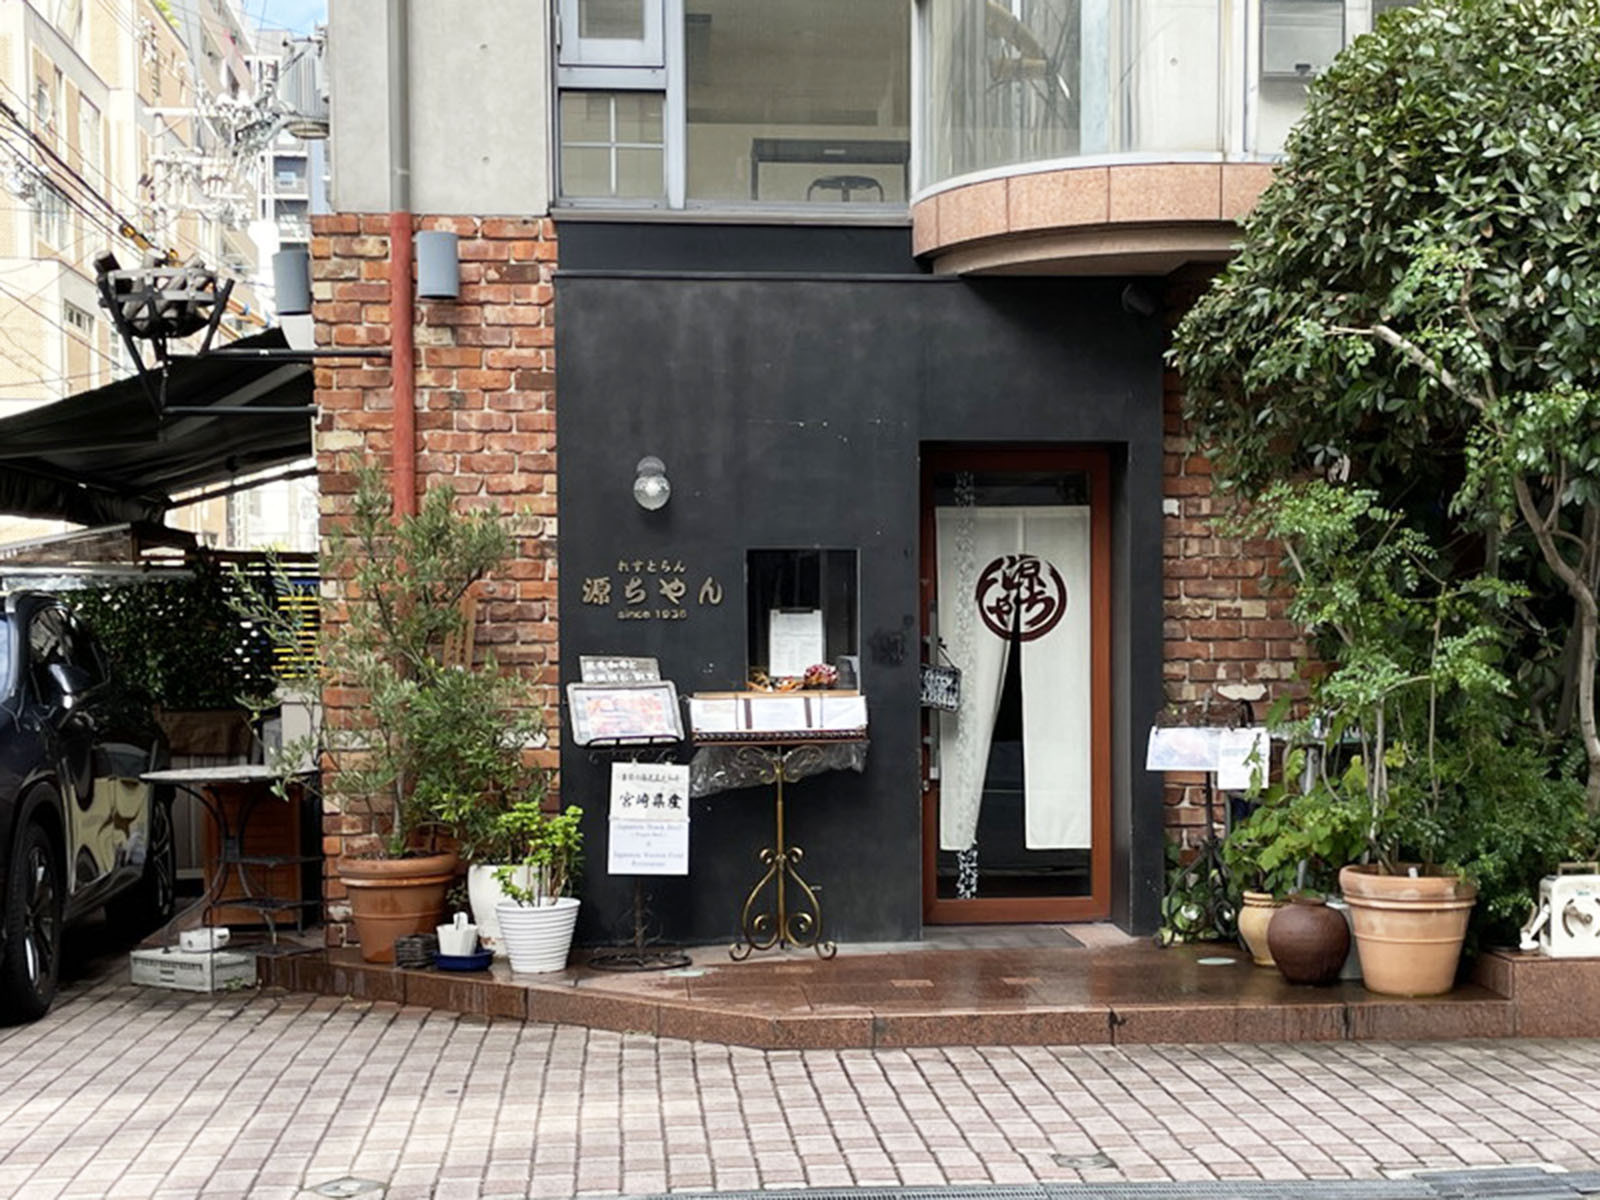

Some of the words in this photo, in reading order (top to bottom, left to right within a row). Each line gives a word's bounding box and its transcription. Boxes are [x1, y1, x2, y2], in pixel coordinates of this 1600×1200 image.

[617, 559, 686, 573] れすとらん
